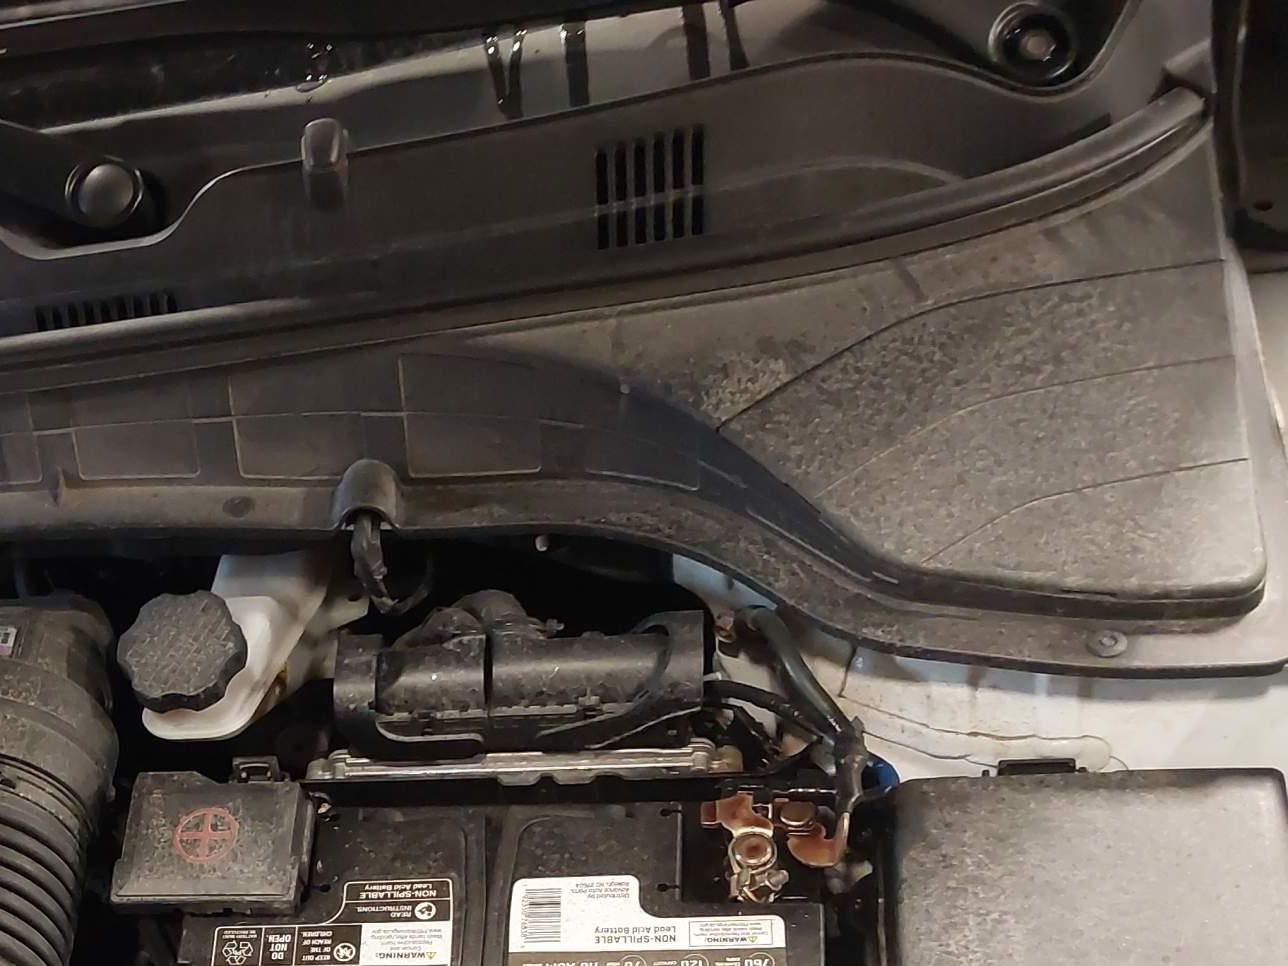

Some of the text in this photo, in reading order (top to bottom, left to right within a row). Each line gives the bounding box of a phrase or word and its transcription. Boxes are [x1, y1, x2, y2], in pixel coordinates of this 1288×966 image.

[359, 890, 437, 899] NON-SPILLABLE
[595, 926, 629, 934] Battery
[266, 934, 291, 942] OPEN.
[595, 934, 676, 944] NON-SPILLABLE
[272, 952, 284, 960] DO
